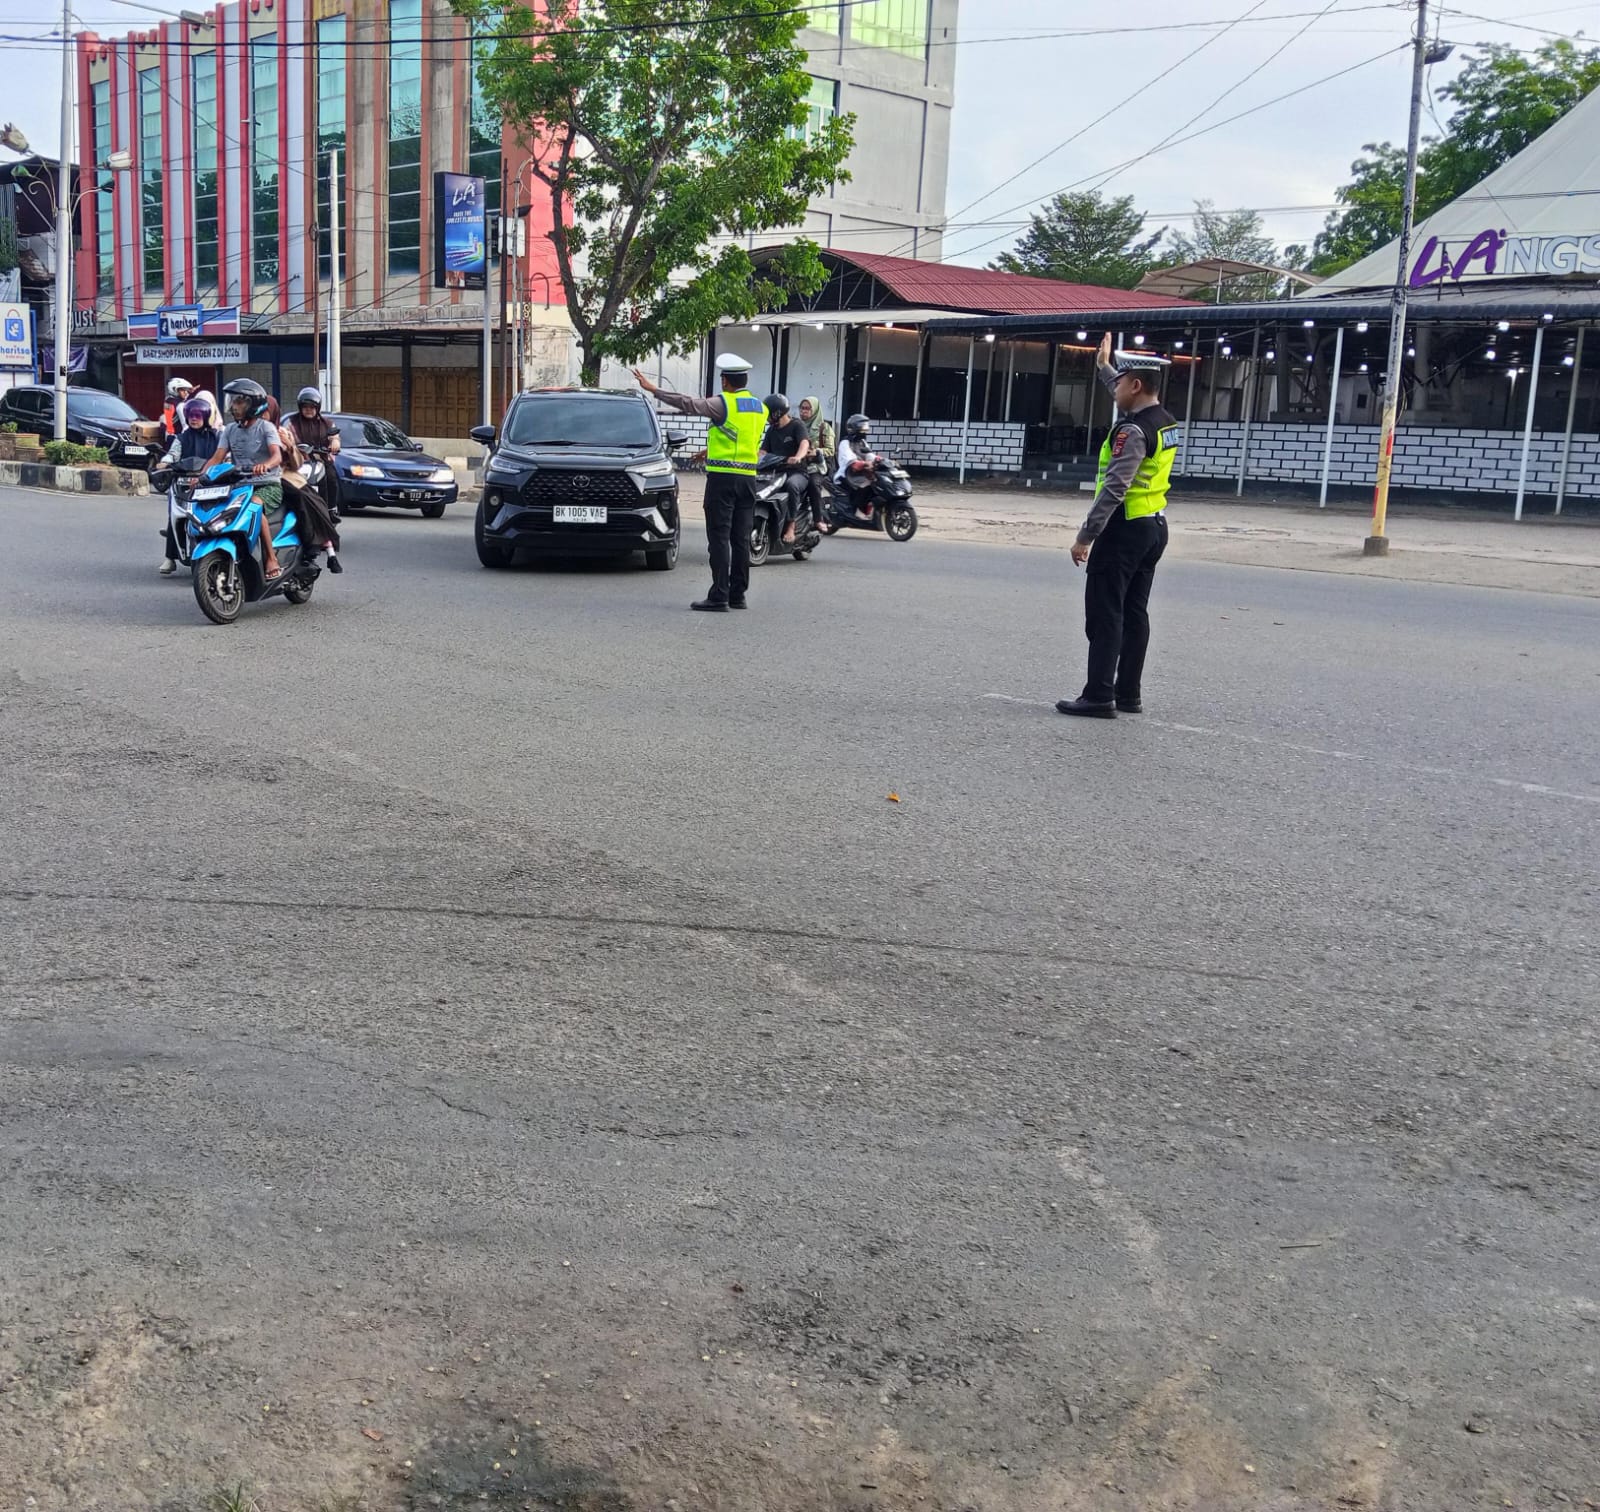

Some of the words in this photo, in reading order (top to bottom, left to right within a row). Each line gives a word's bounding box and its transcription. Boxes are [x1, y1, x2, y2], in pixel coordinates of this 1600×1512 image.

[170, 313, 197, 329] haritsa
[174, 348, 198, 358] FAVORIT
[199, 348, 211, 358] GEN
[555, 507, 566, 517] BK
[568, 507, 588, 517] 1005
